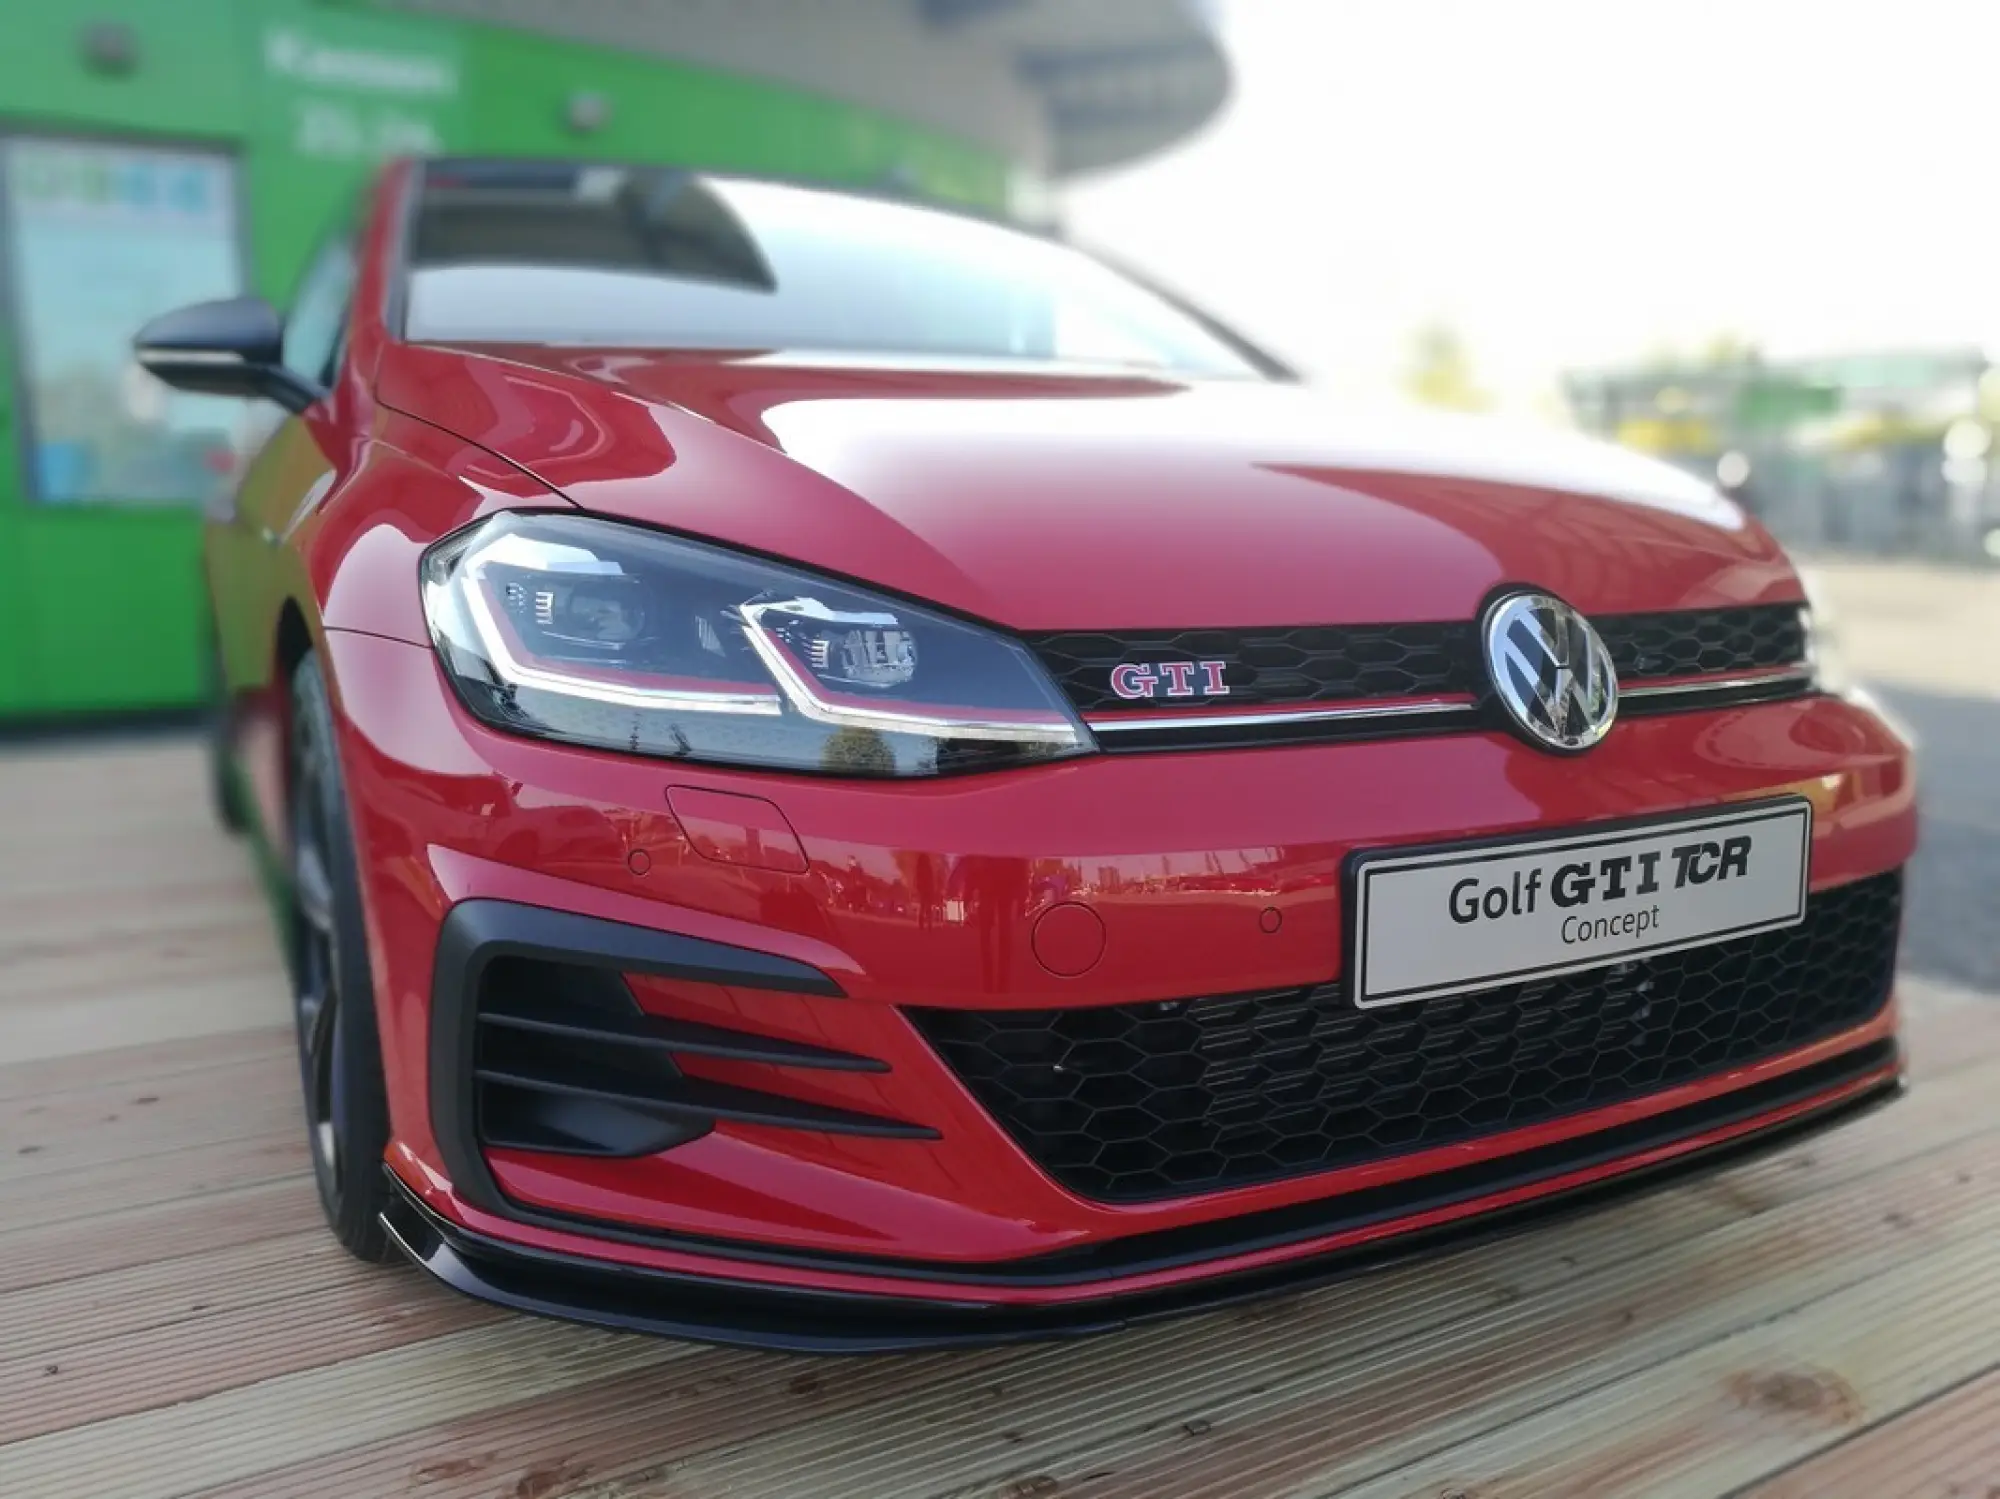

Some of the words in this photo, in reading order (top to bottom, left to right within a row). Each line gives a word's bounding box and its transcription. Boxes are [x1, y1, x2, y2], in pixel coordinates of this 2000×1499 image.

[1111, 660, 1230, 699] GTI
[1449, 869, 1542, 924] Golf
[1550, 851, 1661, 908] GTI
[1671, 835, 1752, 889] TCR
[1561, 904, 1660, 944] Concept
